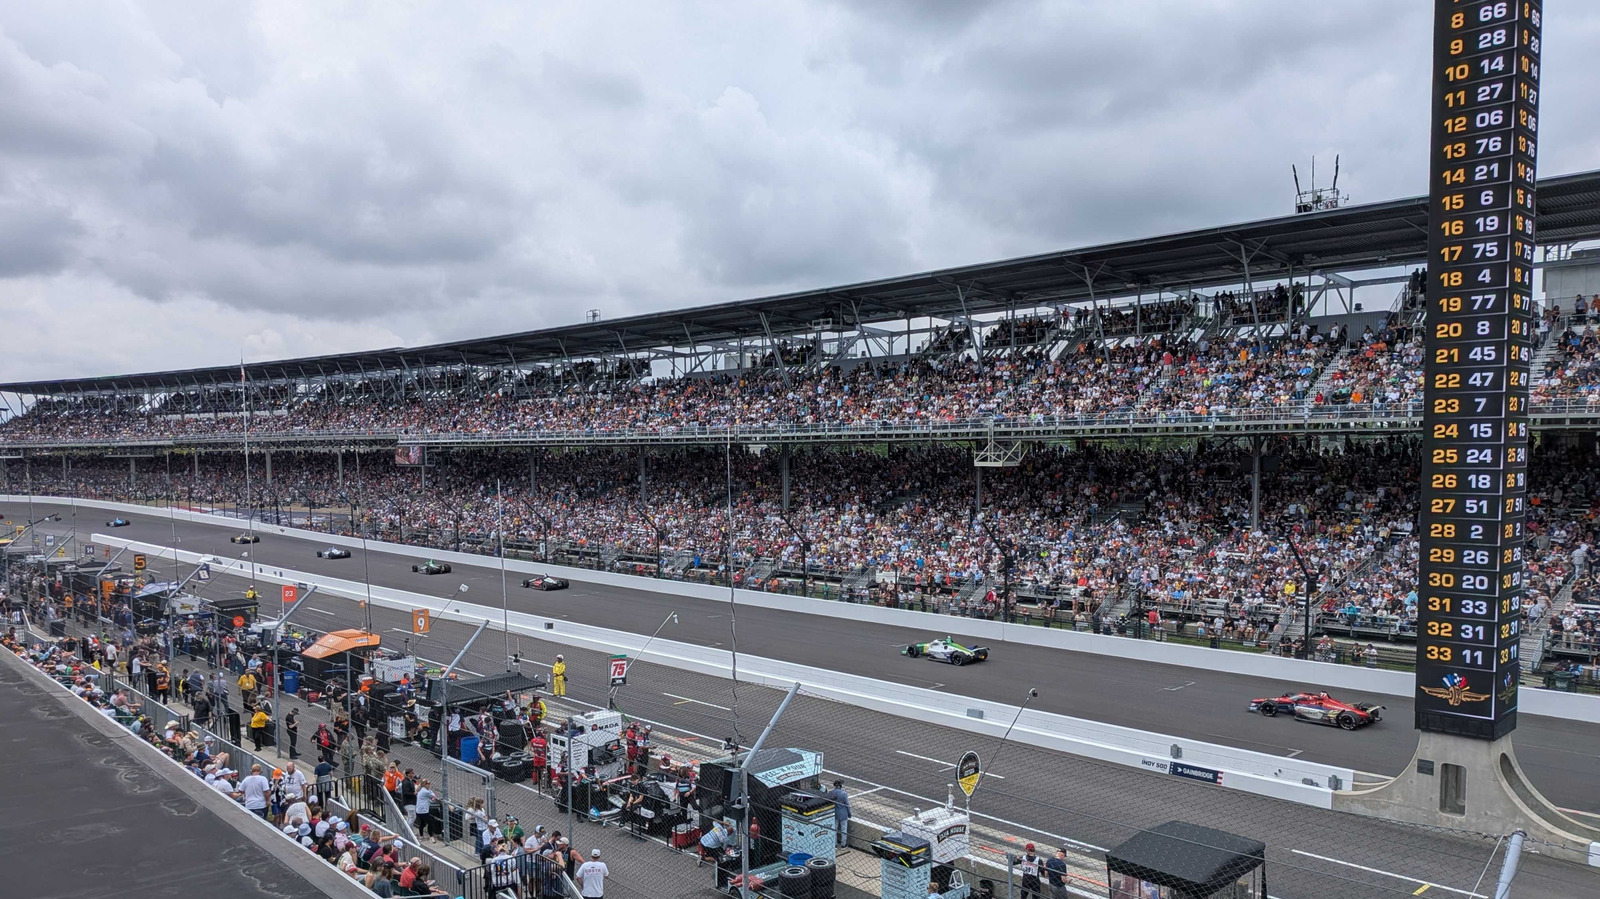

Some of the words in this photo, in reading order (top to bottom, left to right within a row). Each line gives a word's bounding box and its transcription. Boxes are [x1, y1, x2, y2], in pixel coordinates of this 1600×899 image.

[1451, 13, 1464, 28] 8
[1480, 3, 1507, 21] 66
[1524, 2, 1530, 18] 8
[1532, 10, 1540, 28] 66
[1451, 39, 1463, 54] 9
[1479, 30, 1506, 49] 28
[1524, 30, 1528, 44] 9
[1530, 36, 1540, 54] 28
[1445, 65, 1469, 81] 10
[1481, 56, 1504, 74] 14
[1522, 56, 1528, 72] 10
[1530, 62, 1538, 80] 14
[1445, 91, 1465, 107] 11
[1478, 83, 1503, 101] 27
[1520, 82, 1528, 100] 11
[1530, 88, 1536, 106] 27
[1444, 117, 1467, 133] 12
[1476, 110, 1503, 127] 06
[1520, 108, 1526, 126] 12
[1528, 114, 1536, 132] 06
[1443, 143, 1466, 159] 13
[1476, 137, 1501, 154] 76
[1518, 136, 1526, 152] 13
[1526, 140, 1536, 158] 76
[1443, 169, 1465, 185] 14
[1475, 163, 1498, 180] 21
[1518, 162, 1526, 178] 14
[1526, 168, 1534, 184] 21
[1442, 194, 1464, 210] 15
[1481, 191, 1493, 205] 6
[1516, 188, 1524, 206] 15
[1526, 194, 1532, 208] 6
[1441, 220, 1464, 236] 16
[1476, 216, 1498, 232] 19
[1516, 214, 1524, 232] 16
[1524, 218, 1532, 234] 19
[1441, 246, 1462, 261] 17
[1473, 242, 1498, 258] 75
[1514, 240, 1522, 256] 17
[1524, 244, 1532, 260] 75
[1440, 272, 1462, 287] 18
[1478, 269, 1491, 283] 4
[1514, 266, 1522, 282] 18
[1524, 270, 1530, 286] 4
[1439, 298, 1462, 312] 19
[1471, 295, 1496, 309] 77
[1512, 294, 1520, 308] 19
[1522, 296, 1530, 310] 77
[1436, 323, 1462, 338] 20
[1477, 321, 1490, 335] 8
[1512, 320, 1520, 334] 20
[1522, 322, 1528, 336] 8
[1436, 349, 1459, 363] 21
[1469, 346, 1496, 361] 45
[1510, 346, 1518, 360] 21
[1520, 346, 1528, 362] 45
[1435, 374, 1460, 388] 22
[1469, 372, 1494, 386] 47
[1510, 372, 1518, 386] 22
[1520, 372, 1528, 386] 47
[1434, 399, 1459, 413] 23
[1475, 398, 1486, 412] 7
[1508, 398, 1518, 412] 23
[1520, 398, 1526, 412] 7
[1434, 424, 1458, 438] 24
[1470, 424, 1492, 437] 15
[1508, 422, 1516, 436] 24
[1518, 422, 1526, 436] 15
[1433, 449, 1458, 463] 25
[1467, 449, 1492, 463] 24
[1508, 448, 1516, 462] 25
[1516, 448, 1526, 462] 24
[1432, 475, 1457, 488] 26
[1468, 475, 1490, 488] 18
[1506, 474, 1516, 488] 26
[1516, 472, 1524, 486] 18
[1431, 499, 1455, 513] 27
[1466, 500, 1487, 513] 51
[1506, 498, 1514, 514] 27
[1514, 498, 1522, 512] 51
[1430, 524, 1455, 538] 28
[1471, 525, 1483, 539] 2
[1504, 524, 1512, 538] 28
[1516, 522, 1520, 536] 2
[135, 556, 146, 569] 5
[1430, 549, 1455, 562] 29
[1463, 550, 1489, 564] 26
[1504, 550, 1512, 564] 29
[1514, 548, 1522, 560] 26
[1429, 573, 1454, 587] 30
[1462, 575, 1488, 589] 20
[1502, 574, 1512, 588] 30
[1512, 572, 1520, 586] 20
[1428, 598, 1451, 612] 31
[1461, 600, 1487, 614] 33
[1502, 598, 1510, 614] 31
[1510, 596, 1520, 610] 33
[418, 617, 424, 630] 9
[1427, 622, 1452, 637] 32
[1461, 625, 1483, 640] 31
[1500, 624, 1510, 638] 32
[1510, 620, 1518, 636] 31
[1427, 646, 1451, 661] 33
[1462, 650, 1482, 664] 11
[1500, 648, 1508, 664] 33
[1510, 644, 1518, 660] 11
[612, 663, 625, 676] 75
[1141, 759, 1155, 767] INDY
[1156, 761, 1168, 770] 500
[1182, 768, 1214, 780] GAINBRIDGE
